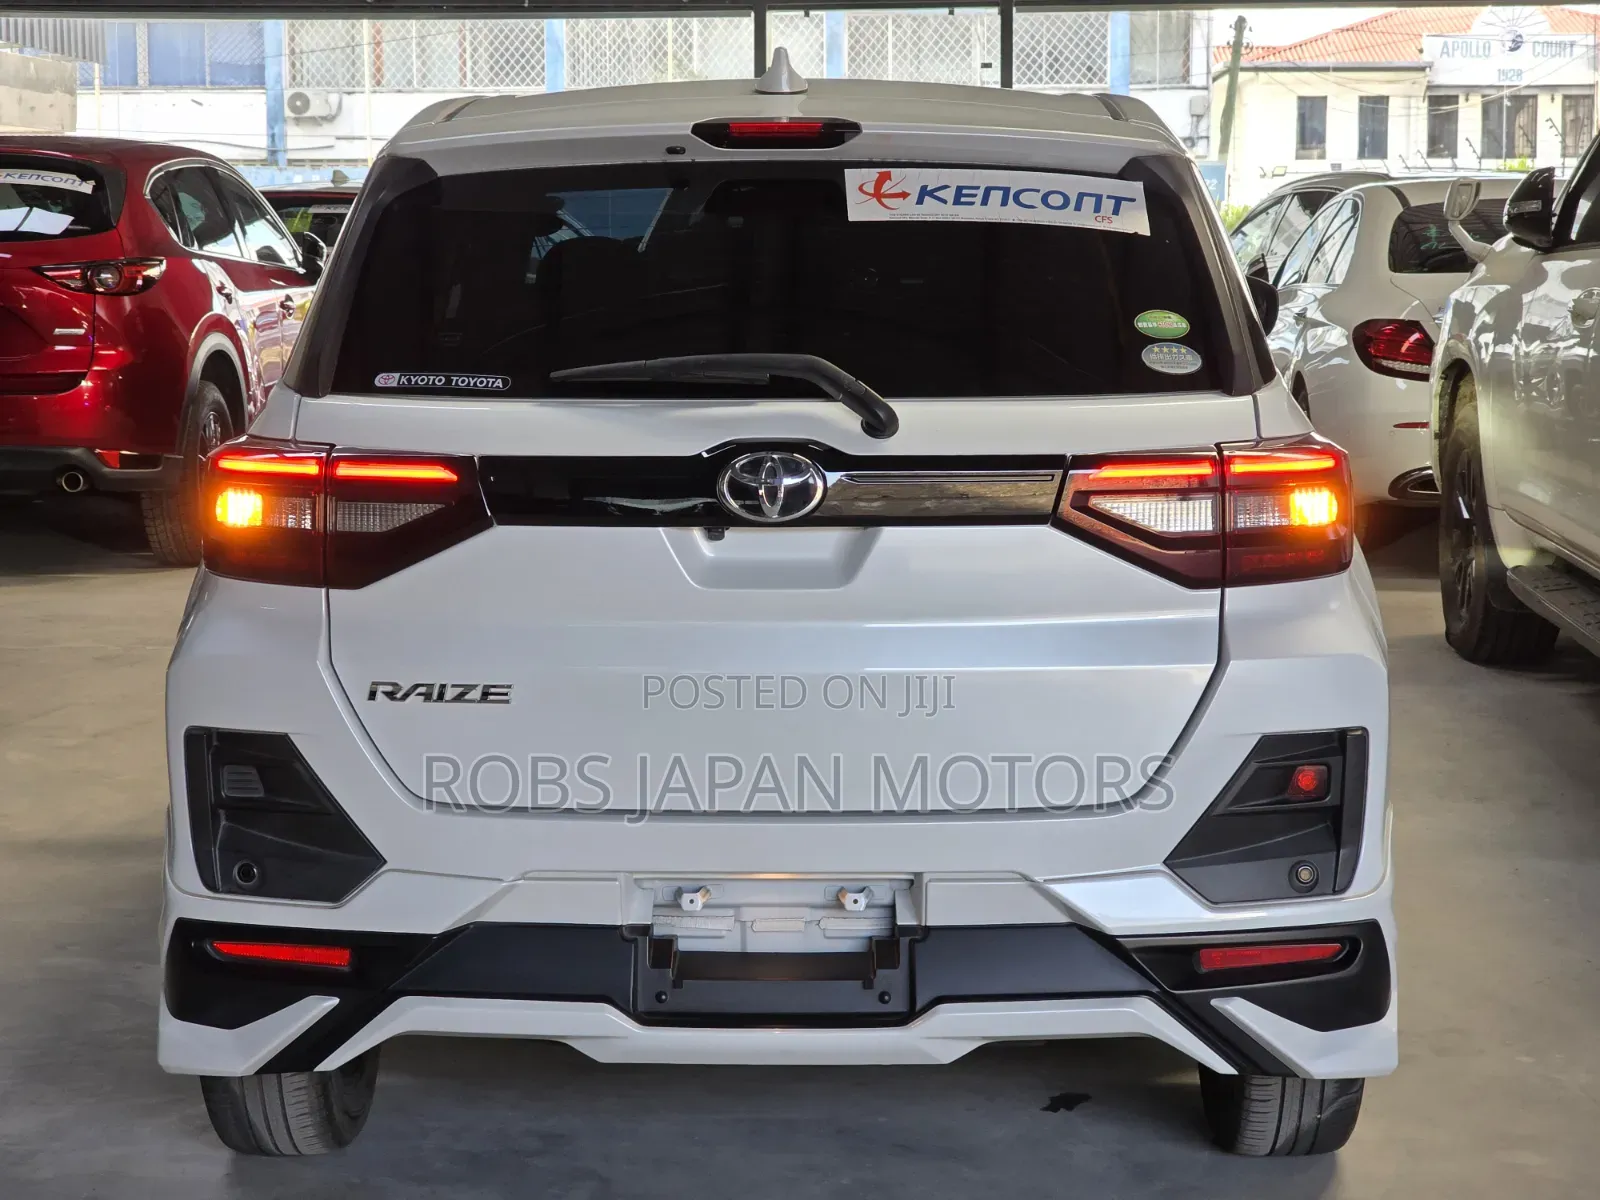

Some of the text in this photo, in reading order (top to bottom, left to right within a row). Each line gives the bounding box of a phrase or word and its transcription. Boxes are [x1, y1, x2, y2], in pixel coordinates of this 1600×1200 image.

[1439, 40, 1577, 58] APOLLO COURT
[915, 184, 1137, 216] KENCONT
[1094, 215, 1114, 225] CFS
[399, 375, 504, 389] KYOTO TOYOTA
[367, 681, 514, 704] RAIZE
